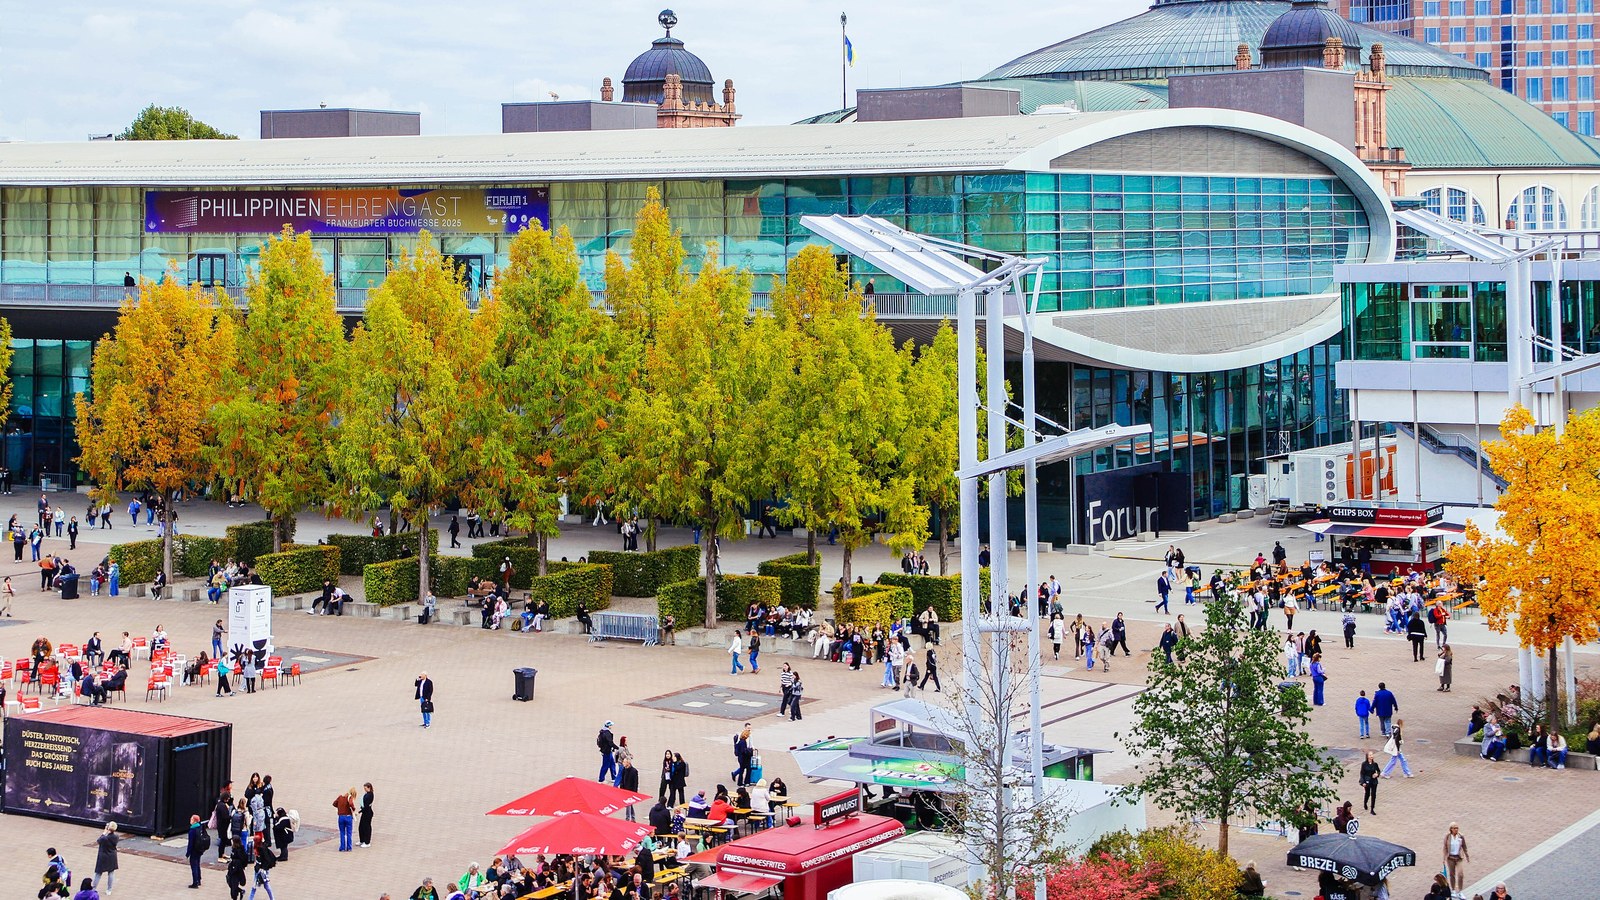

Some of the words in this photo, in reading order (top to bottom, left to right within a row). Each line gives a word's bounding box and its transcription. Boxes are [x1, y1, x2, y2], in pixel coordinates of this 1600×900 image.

[200, 198, 321, 217] PHILIPPINEN
[326, 197, 461, 217] EHRENGAST
[325, 218, 385, 228] FRANKFURTER
[388, 218, 439, 227] BUCHMESSE
[441, 218, 462, 227] 2025
[1332, 508, 1357, 517] CHIPS
[1357, 510, 1374, 518] BOX
[21, 730, 45, 740] DÜSTER,
[45, 733, 80, 745] DYSTOPISCH,
[31, 750, 43, 758] DAS
[26, 759, 41, 768] BUCH
[42, 761, 53, 769] DES
[53, 763, 74, 772] JAHRES
[822, 799, 858, 818] CURRYWURST
[1300, 855, 1338, 873] BREZEL
